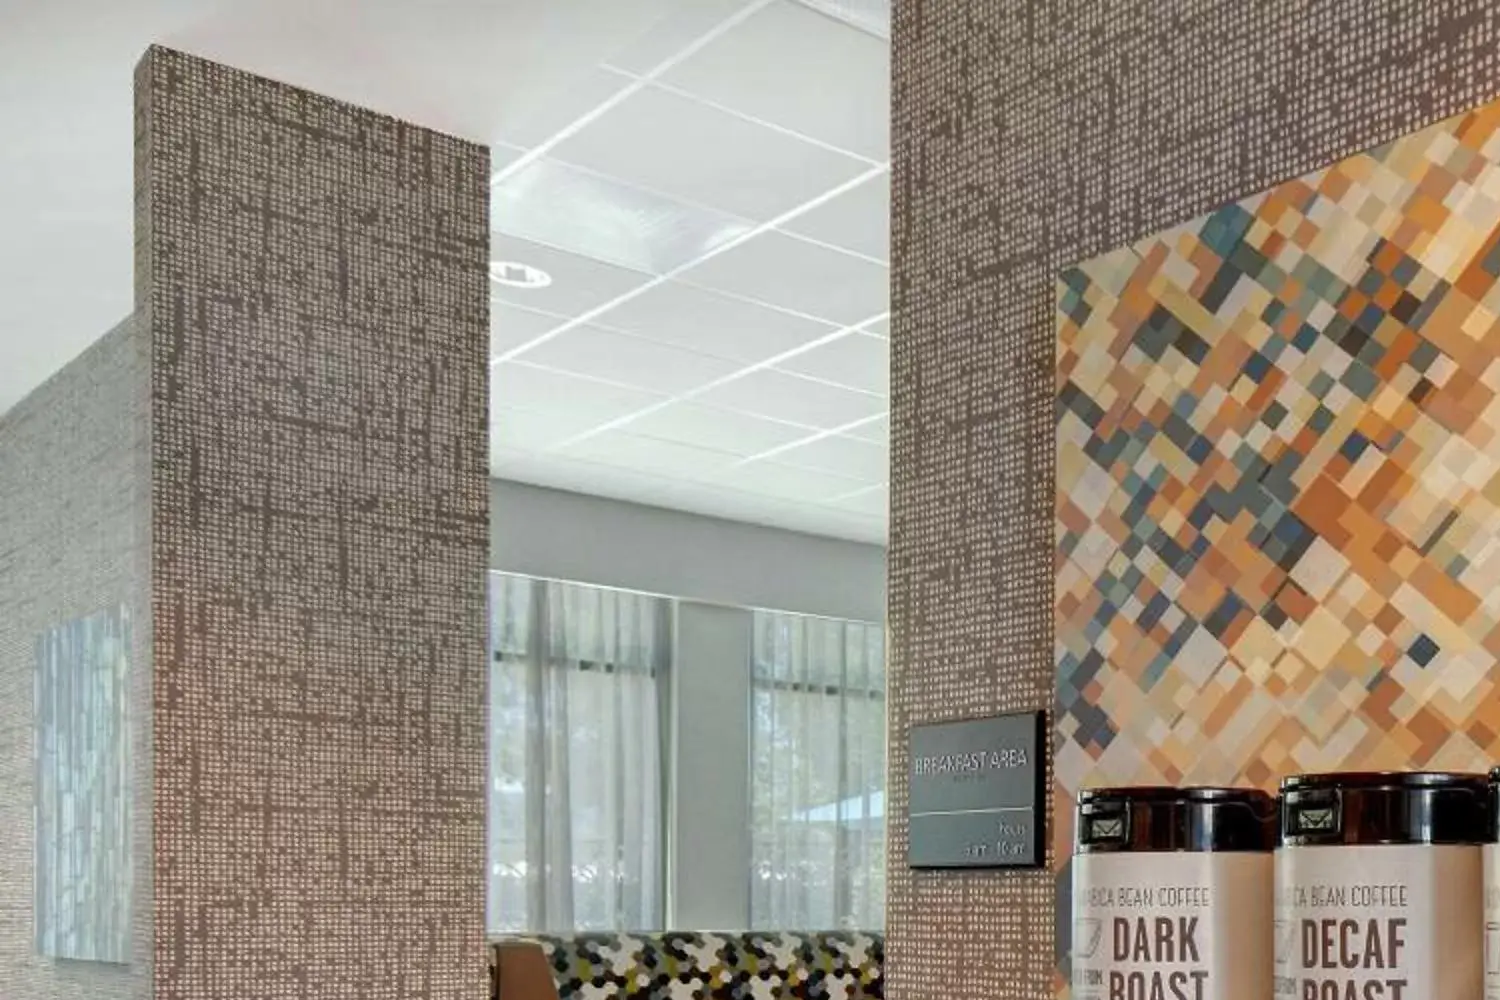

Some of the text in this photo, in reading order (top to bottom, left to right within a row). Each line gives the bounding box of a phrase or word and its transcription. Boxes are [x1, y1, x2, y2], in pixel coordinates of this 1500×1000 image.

[915, 748, 1028, 776] BREAKFAST AREA
[1119, 887, 1153, 907] BEAN
[1159, 887, 1209, 907] COFFEE
[1311, 885, 1345, 907] BEAN
[1351, 885, 1408, 907] COFFEE
[1113, 916, 1200, 962] DARK
[1301, 917, 1408, 969] DECAF
